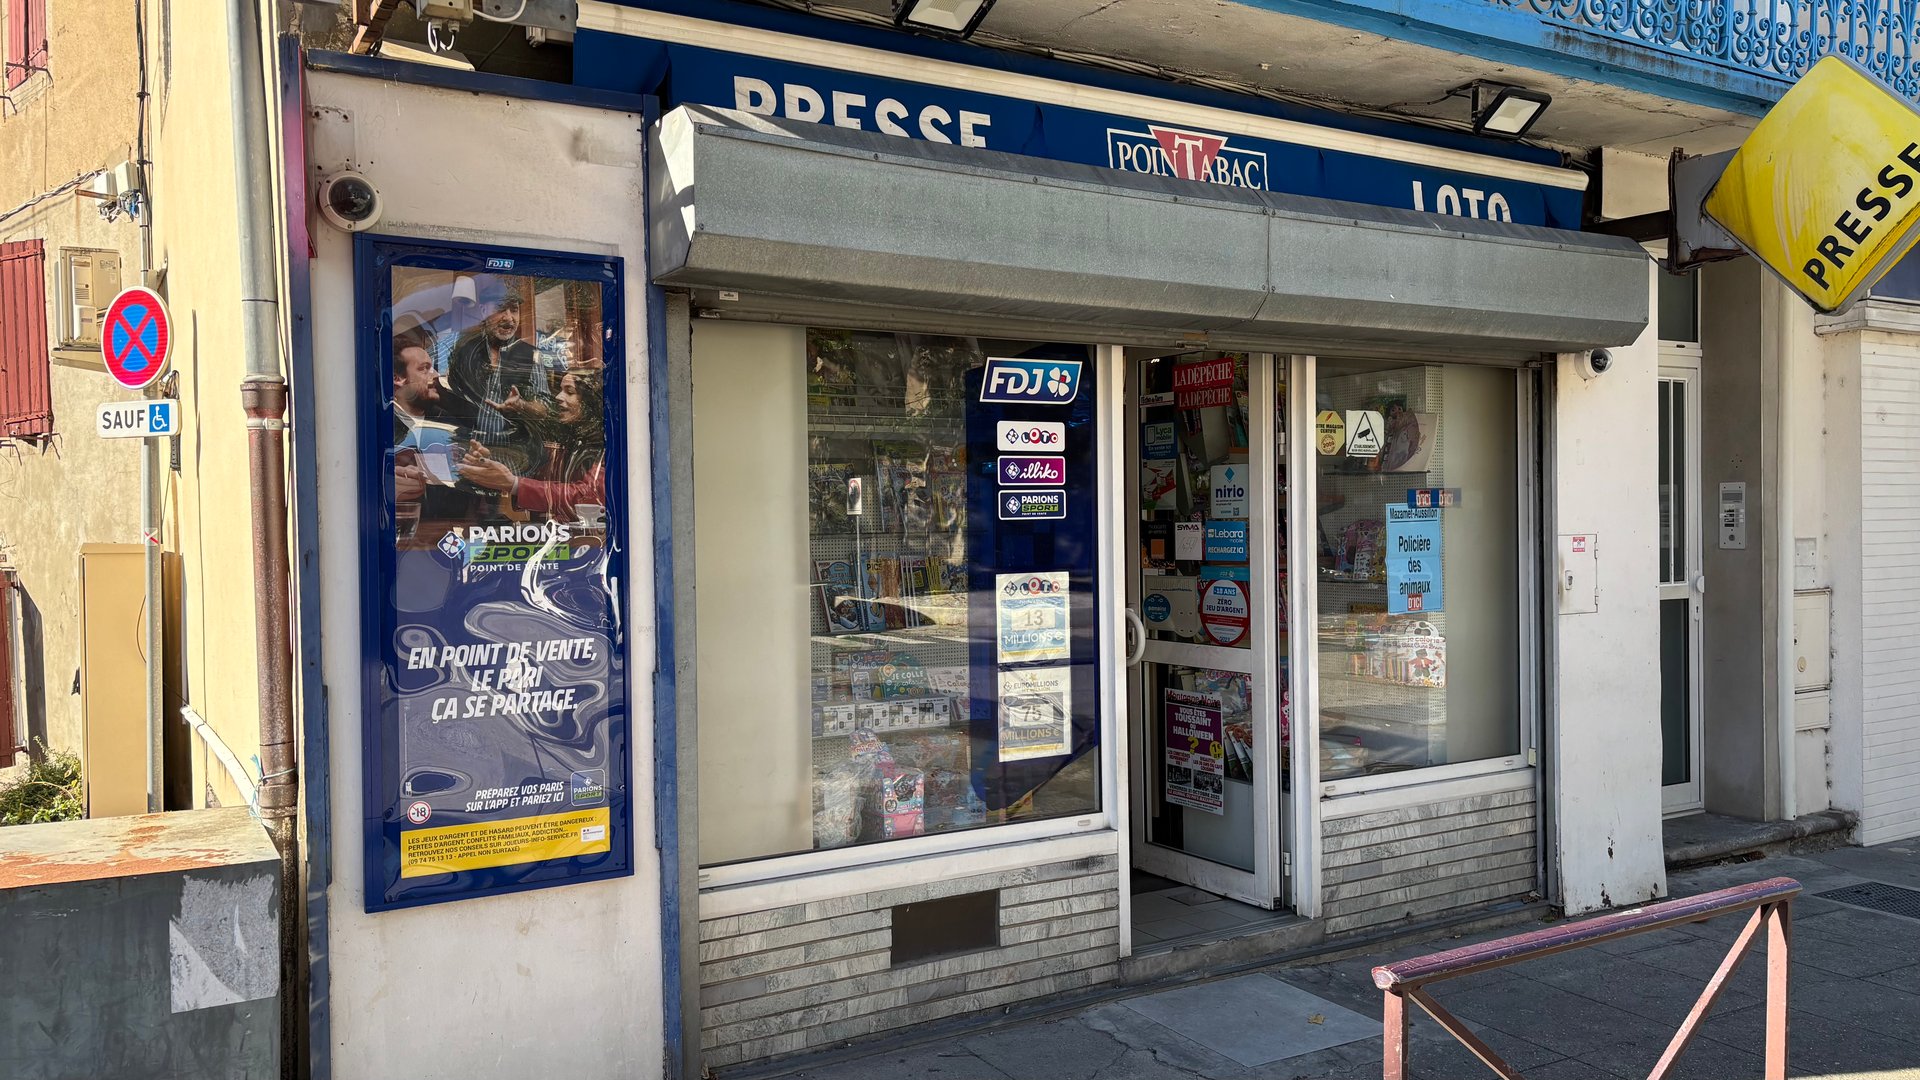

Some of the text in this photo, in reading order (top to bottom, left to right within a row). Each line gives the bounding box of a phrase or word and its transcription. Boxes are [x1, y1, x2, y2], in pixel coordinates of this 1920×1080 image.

[1802, 142, 1920, 290] PRESSE
[488, 260, 504, 268] FDJ
[989, 366, 1044, 395] FDJ
[1174, 362, 1232, 386] LA DÉPÊCHE
[1189, 387, 1231, 406] DÉPÊCHE
[102, 410, 145, 429] SAUF
[1020, 428, 1058, 444] LOTO
[1020, 462, 1058, 479] illiko
[1215, 484, 1244, 498] nirio
[1022, 495, 1058, 504] PARIONS
[470, 525, 570, 543] PARIONS
[1214, 528, 1244, 538] Lebara
[1399, 535, 1431, 552] Policière
[1408, 558, 1422, 573] des
[1020, 577, 1060, 595] LOTO
[1400, 578, 1431, 595] animaux
[1024, 610, 1043, 626] 13
[1004, 632, 1052, 645] MILLIONS
[408, 638, 597, 669] EN POINT DE VENTE,
[471, 666, 543, 692] LE PARI
[1014, 680, 1058, 689] EUROMILLIONS
[432, 689, 578, 723] ÇA SE PARTAGE.
[1022, 706, 1042, 722] 75
[1180, 707, 1206, 718] VOUS ÊTES
[1175, 713, 1212, 727] TOUSSAINT
[1003, 728, 1051, 740] MILLIONS
[1173, 726, 1214, 741] HALLOWEEN
[475, 781, 564, 800] PRÉPAREZ VOS PARIS
[574, 785, 602, 794] PARIONS
[465, 792, 564, 813] SUR L'APP ET PARIEZ ICI
[412, 807, 427, 817] -18
[489, 826, 514, 835] HASARD
[515, 823, 542, 831] PEUVENT
[560, 817, 594, 826] DANGEREUX
[498, 832, 531, 840] FAMILIAUX,
[408, 850, 444, 858] RETROUVEZ
[460, 843, 488, 851] CONSEILS
